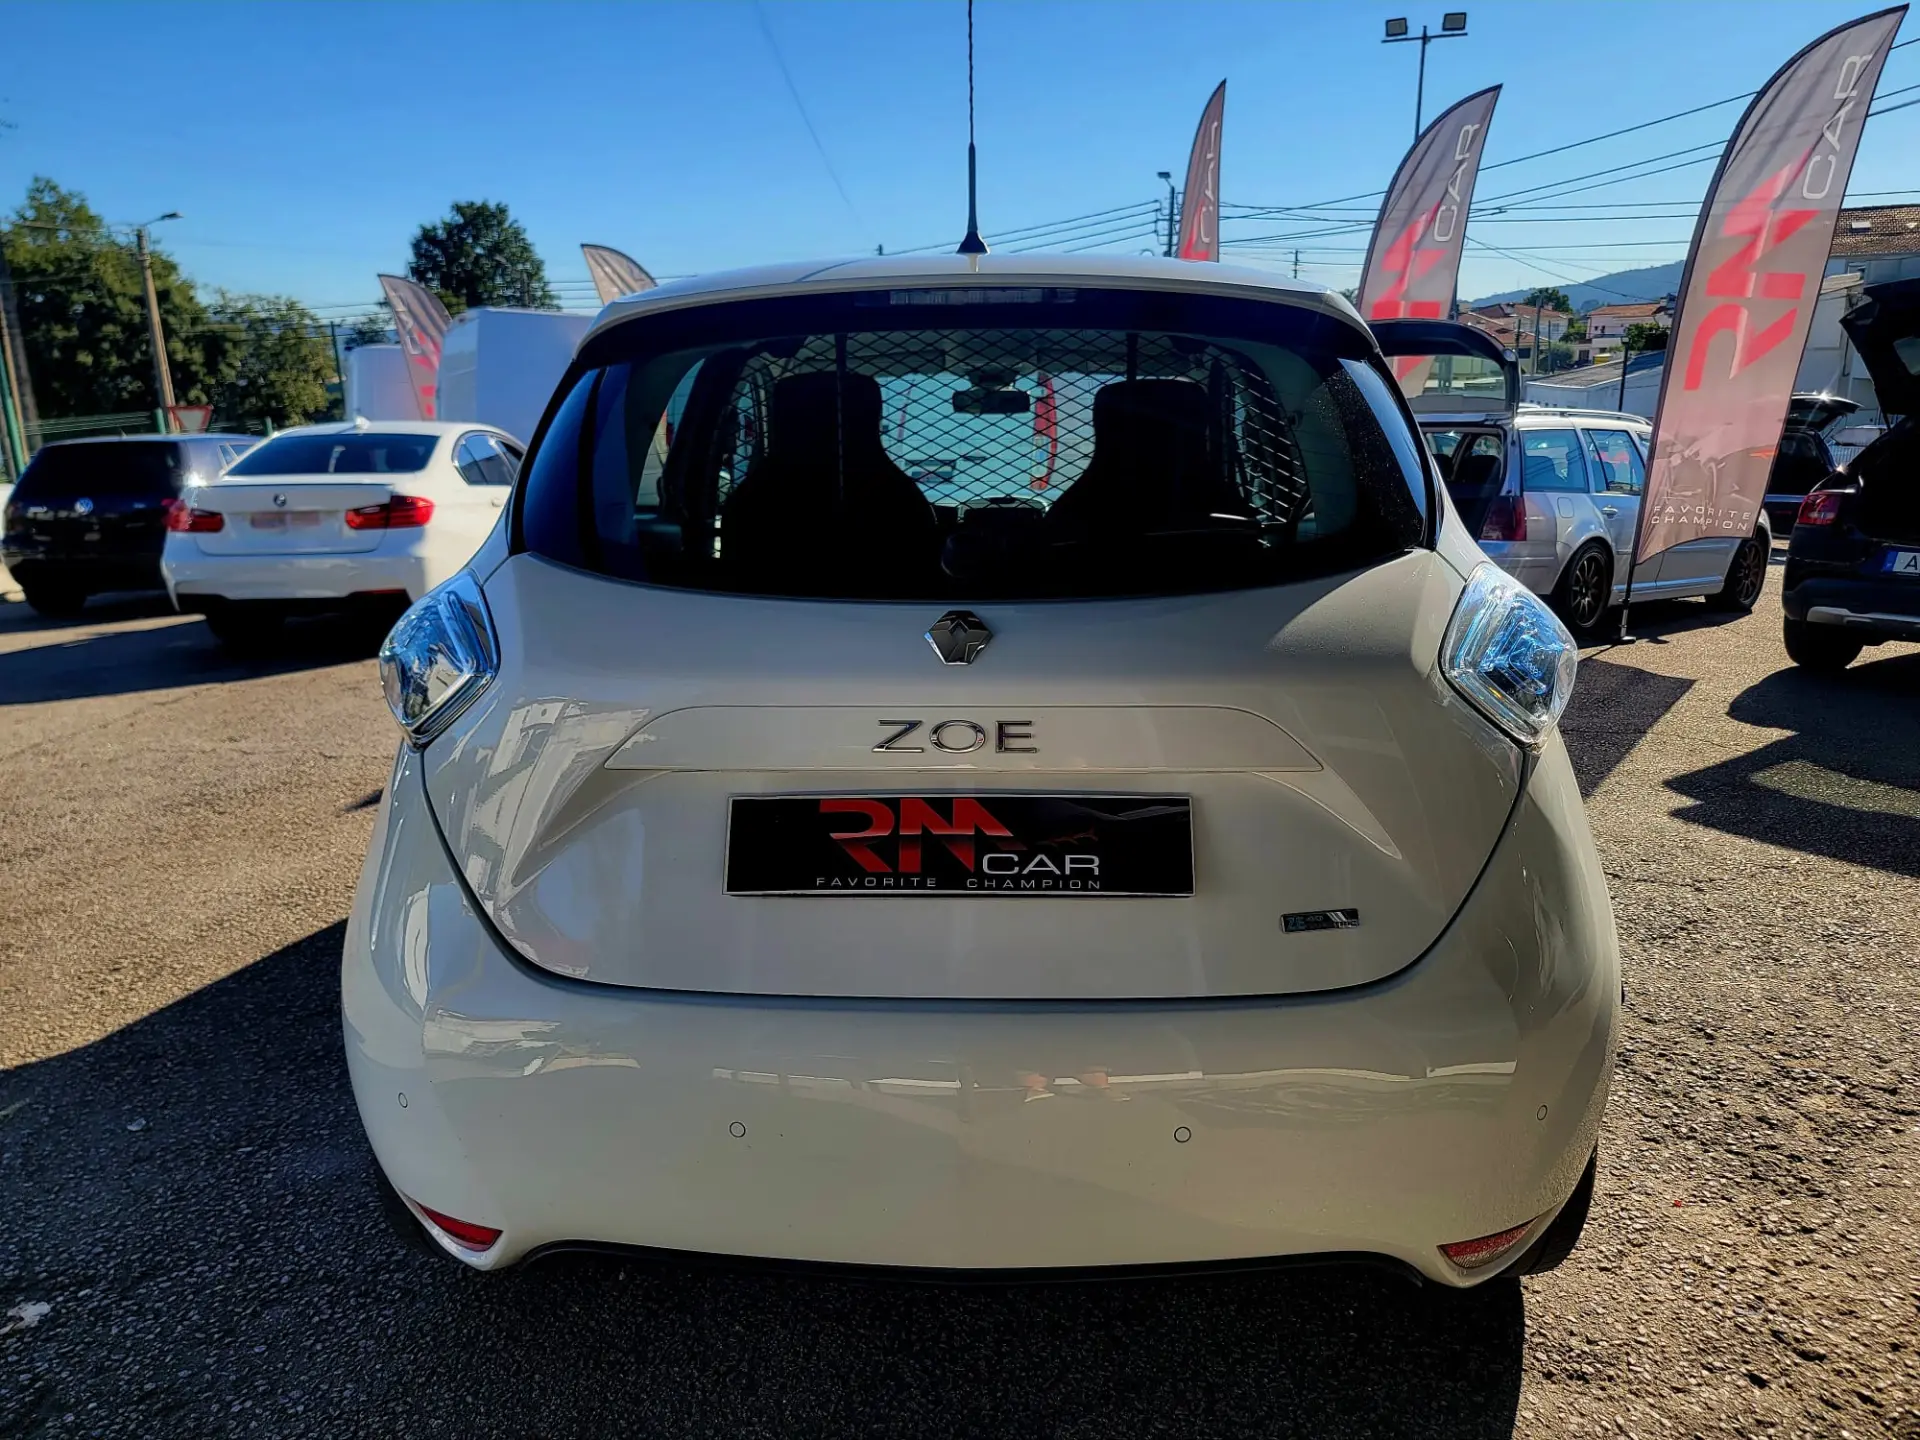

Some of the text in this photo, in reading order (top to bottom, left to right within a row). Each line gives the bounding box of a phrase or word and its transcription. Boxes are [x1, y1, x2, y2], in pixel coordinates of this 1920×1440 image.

[1802, 54, 1873, 200] CAR
[1434, 123, 1481, 241] CAR
[1650, 515, 1748, 531] CHAMPION
[1653, 505, 1752, 520] FAVORITE
[872, 719, 1038, 754] ZOE
[982, 853, 1101, 876] CAR
[815, 876, 1101, 890] FAVORITE CHAMPION
